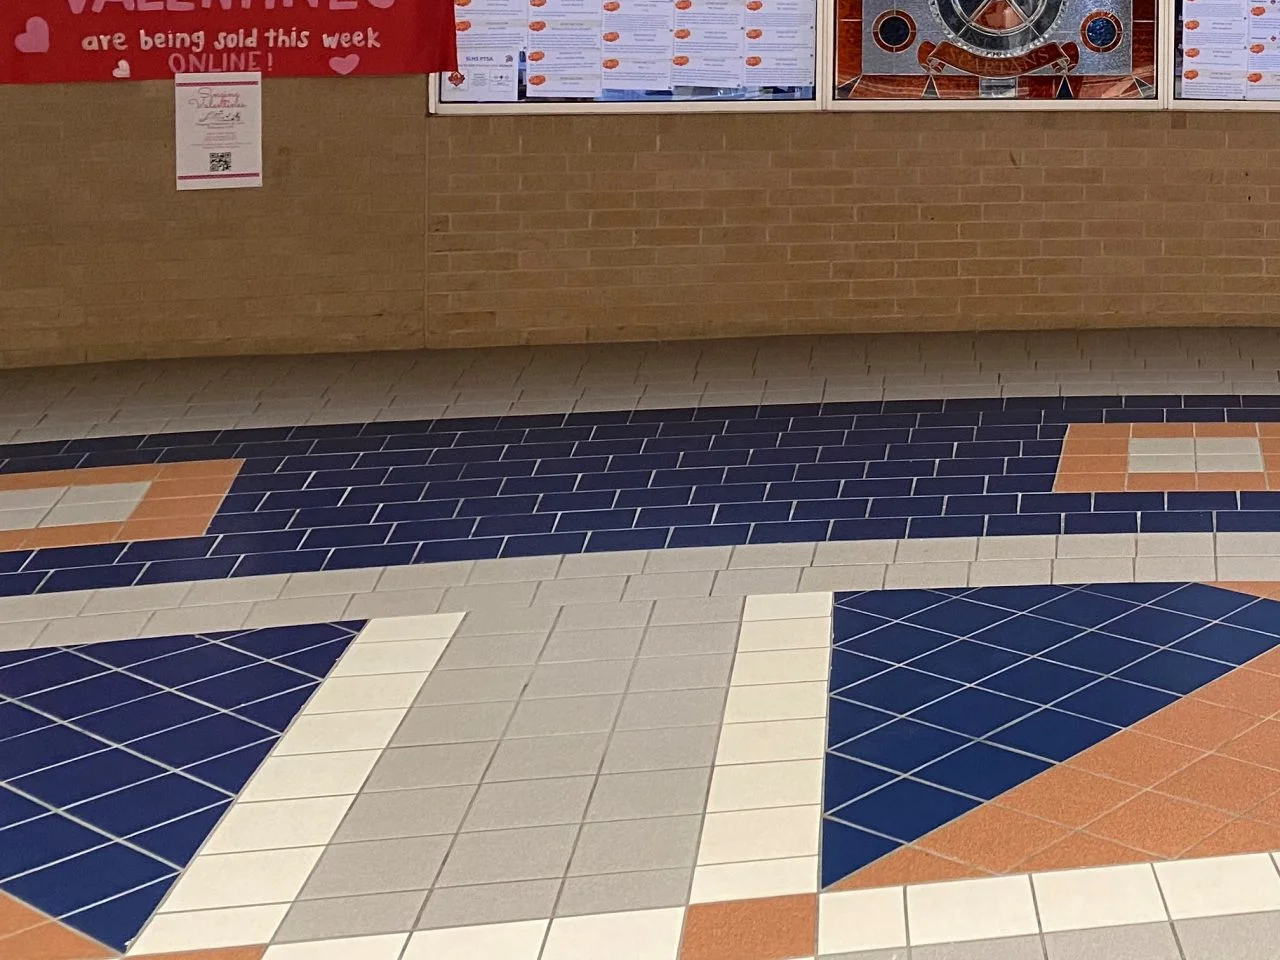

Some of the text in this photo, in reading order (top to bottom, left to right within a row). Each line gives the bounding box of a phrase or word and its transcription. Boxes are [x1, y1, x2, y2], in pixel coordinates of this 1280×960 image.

[81, 26, 381, 53] are being sold this week
